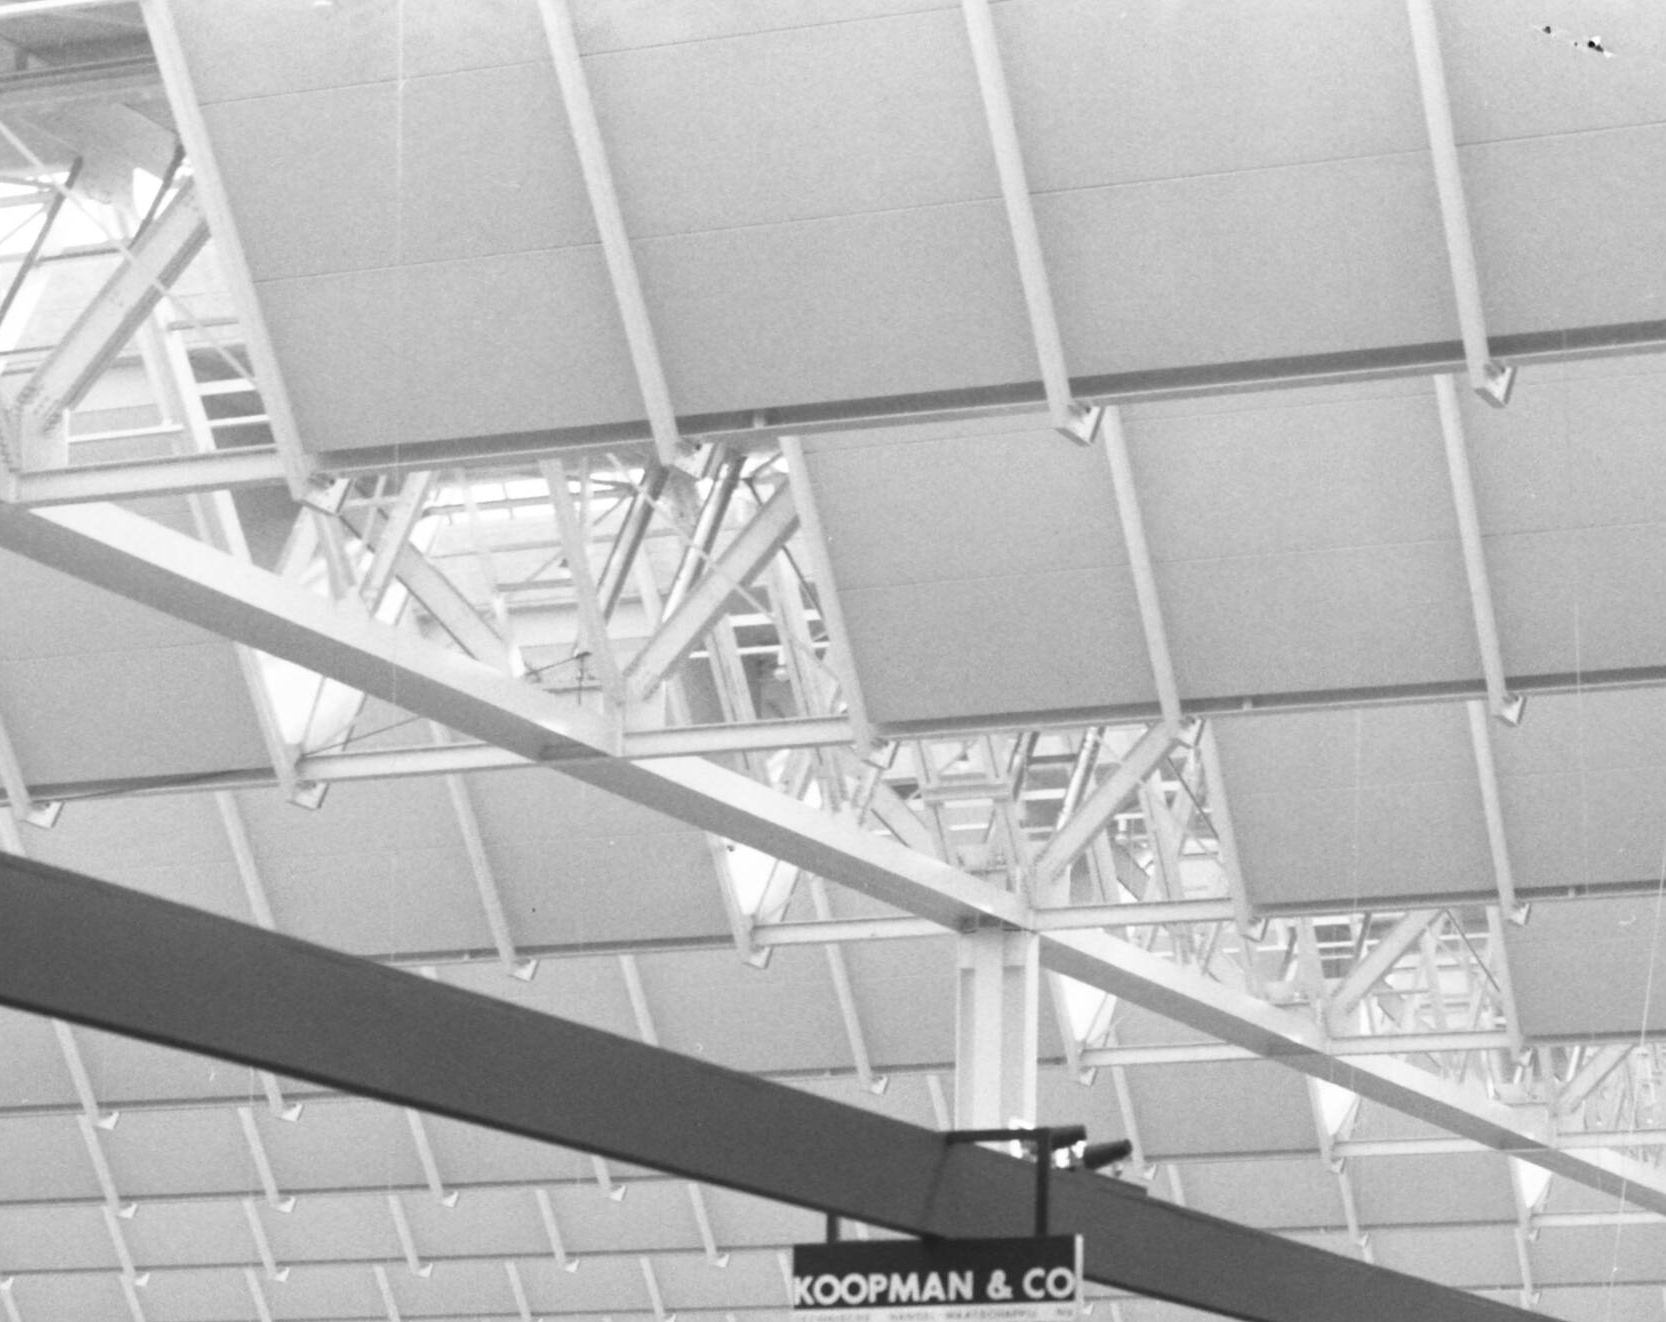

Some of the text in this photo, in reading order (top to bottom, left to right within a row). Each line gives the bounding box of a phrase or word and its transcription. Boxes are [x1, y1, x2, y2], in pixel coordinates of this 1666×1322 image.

[793, 1266, 1077, 1306] KOOPMAN & CO
